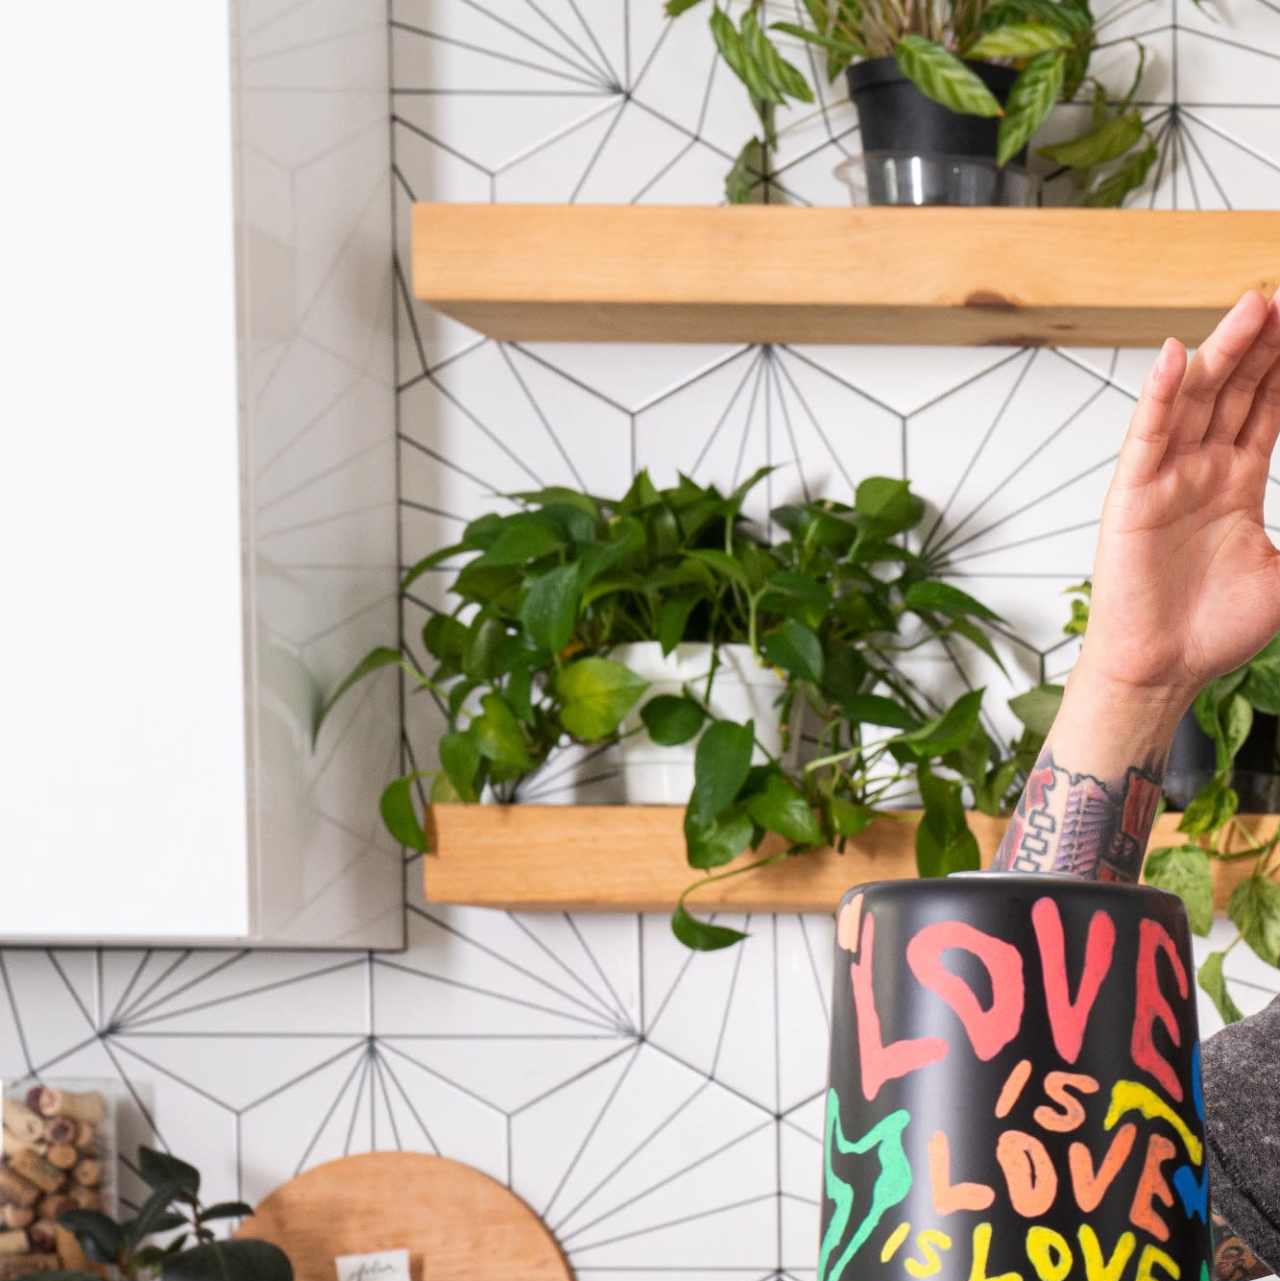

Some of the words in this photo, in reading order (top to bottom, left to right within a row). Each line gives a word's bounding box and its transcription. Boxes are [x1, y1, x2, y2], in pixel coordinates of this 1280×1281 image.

[851, 896, 1188, 1102] LOVE
[995, 1059, 1099, 1132] IS
[928, 1123, 1176, 1242] LOVE
[881, 1222, 952, 1278] IS
